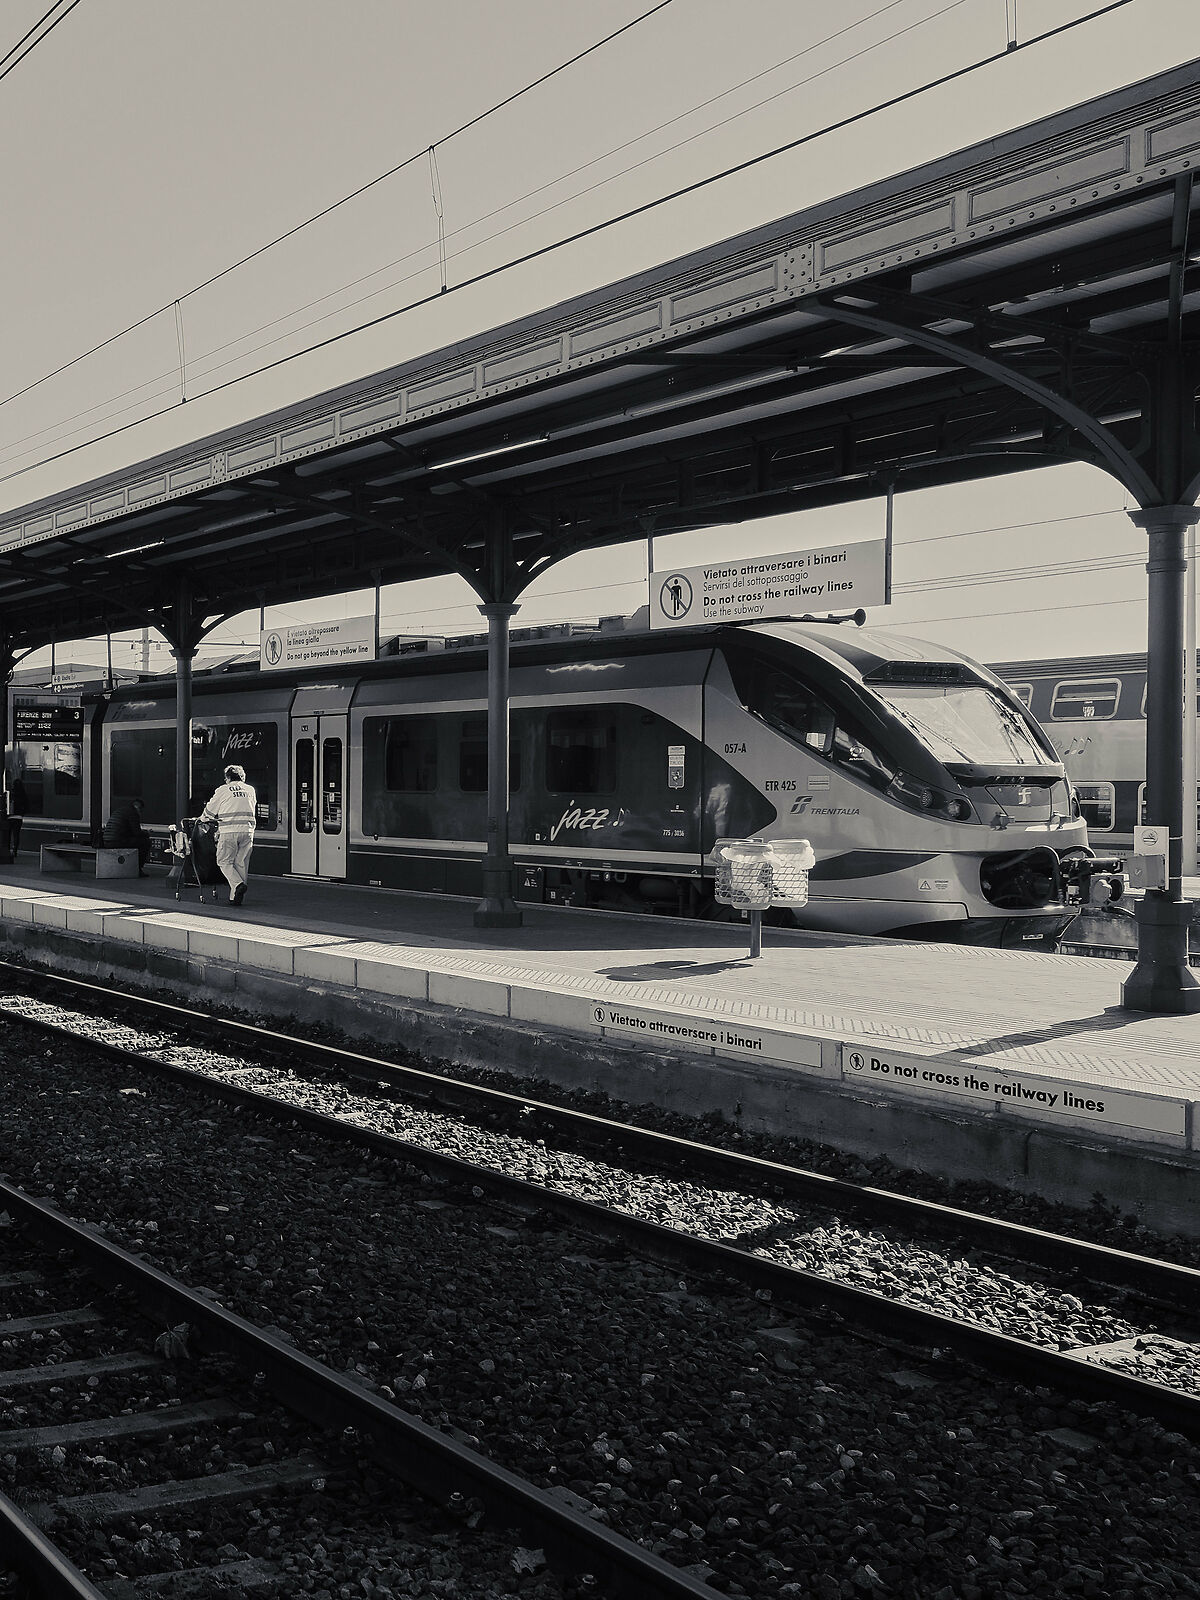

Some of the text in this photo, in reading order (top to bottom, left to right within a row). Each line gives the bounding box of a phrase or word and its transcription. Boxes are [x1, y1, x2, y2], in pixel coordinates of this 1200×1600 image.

[703, 551, 847, 580] Vietato attraversare i binari
[703, 570, 809, 592] Servirsi del sottopassaggio
[703, 580, 854, 606] Do not cross the railway lines
[703, 603, 765, 618] Use the subway
[290, 630, 307, 638] vietato
[305, 636, 320, 646] giallo
[302, 652, 310, 660] go
[310, 649, 329, 658] beyond
[340, 646, 357, 656] yellow
[221, 728, 254, 759] jazz
[724, 742, 746, 754] 057-A
[765, 780, 796, 791] ETR 425
[550, 800, 610, 842] jazz
[609, 1012, 762, 1050] Vietato attraversare i binari
[870, 1058, 1106, 1113] Do not cross the railway lines
